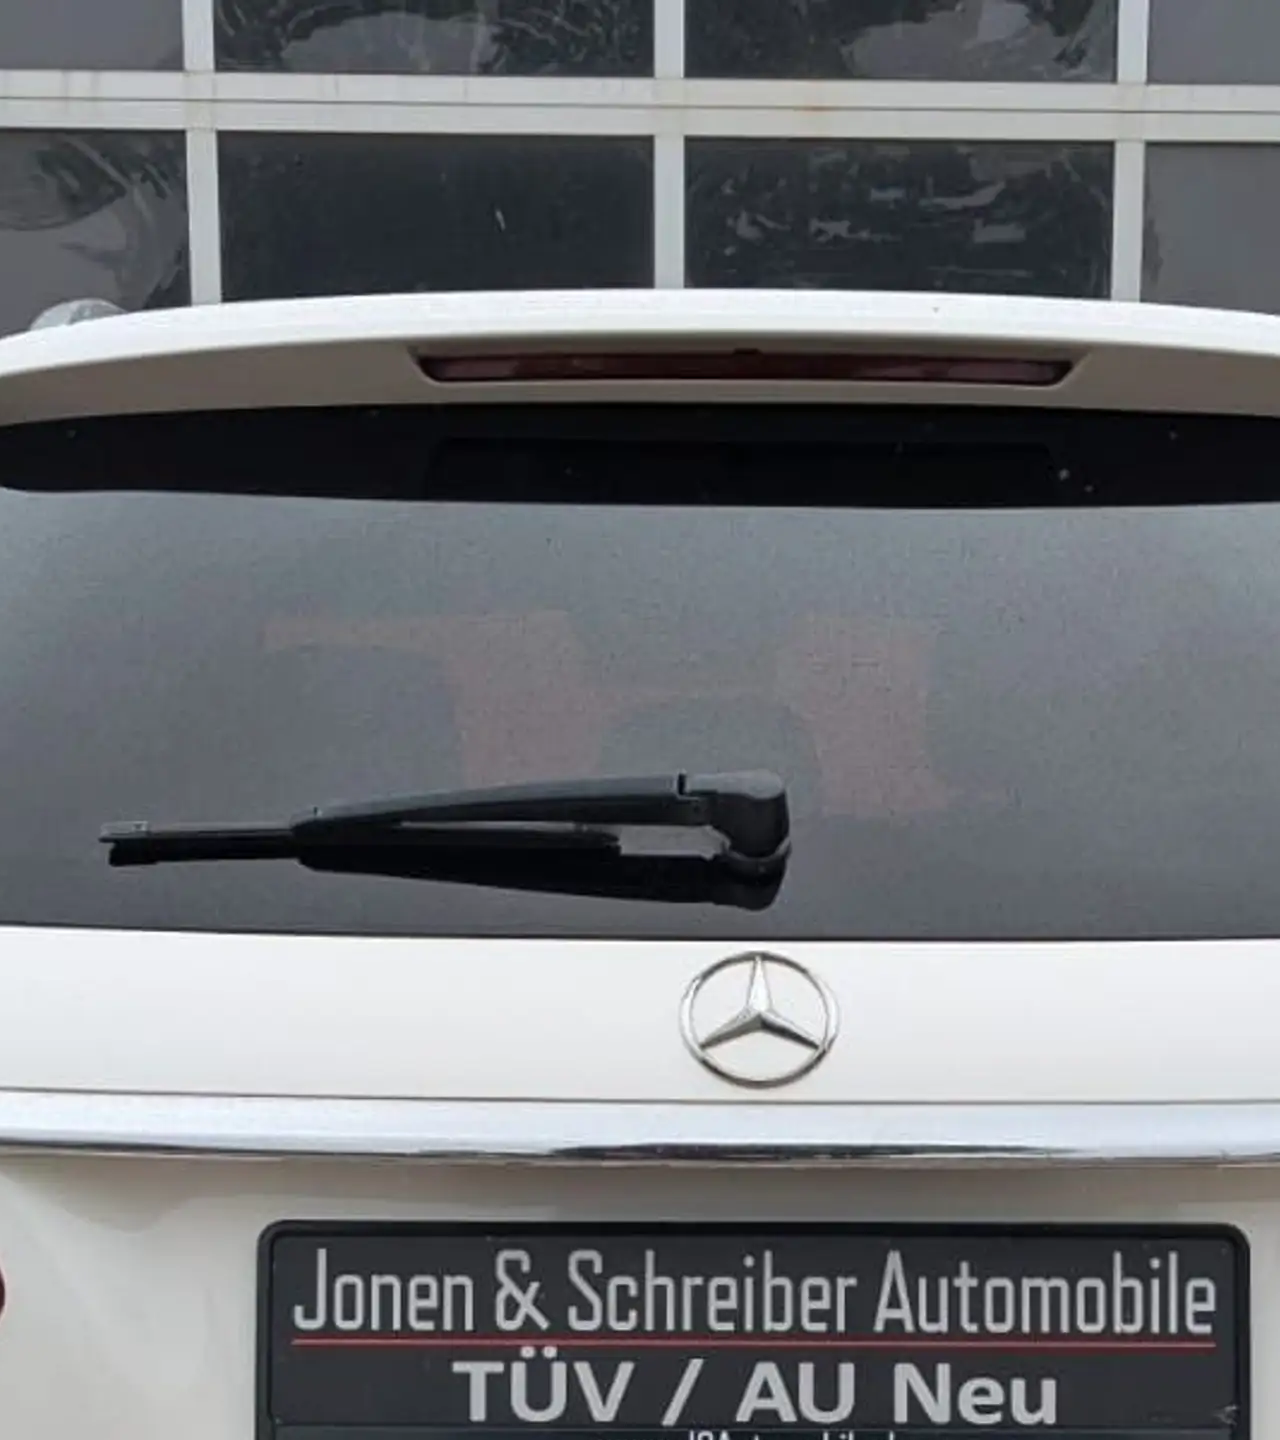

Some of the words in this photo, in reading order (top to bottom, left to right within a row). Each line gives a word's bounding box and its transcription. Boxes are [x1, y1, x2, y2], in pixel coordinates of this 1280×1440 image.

[293, 1248, 474, 1332] Jonen
[495, 1249, 550, 1331] &
[567, 1249, 858, 1333] Schreiber
[873, 1250, 1216, 1334] Automobile
[452, 1345, 635, 1423] TÜV
[661, 1358, 704, 1426] /
[735, 1361, 855, 1424] AU
[894, 1362, 1057, 1425] Neu
